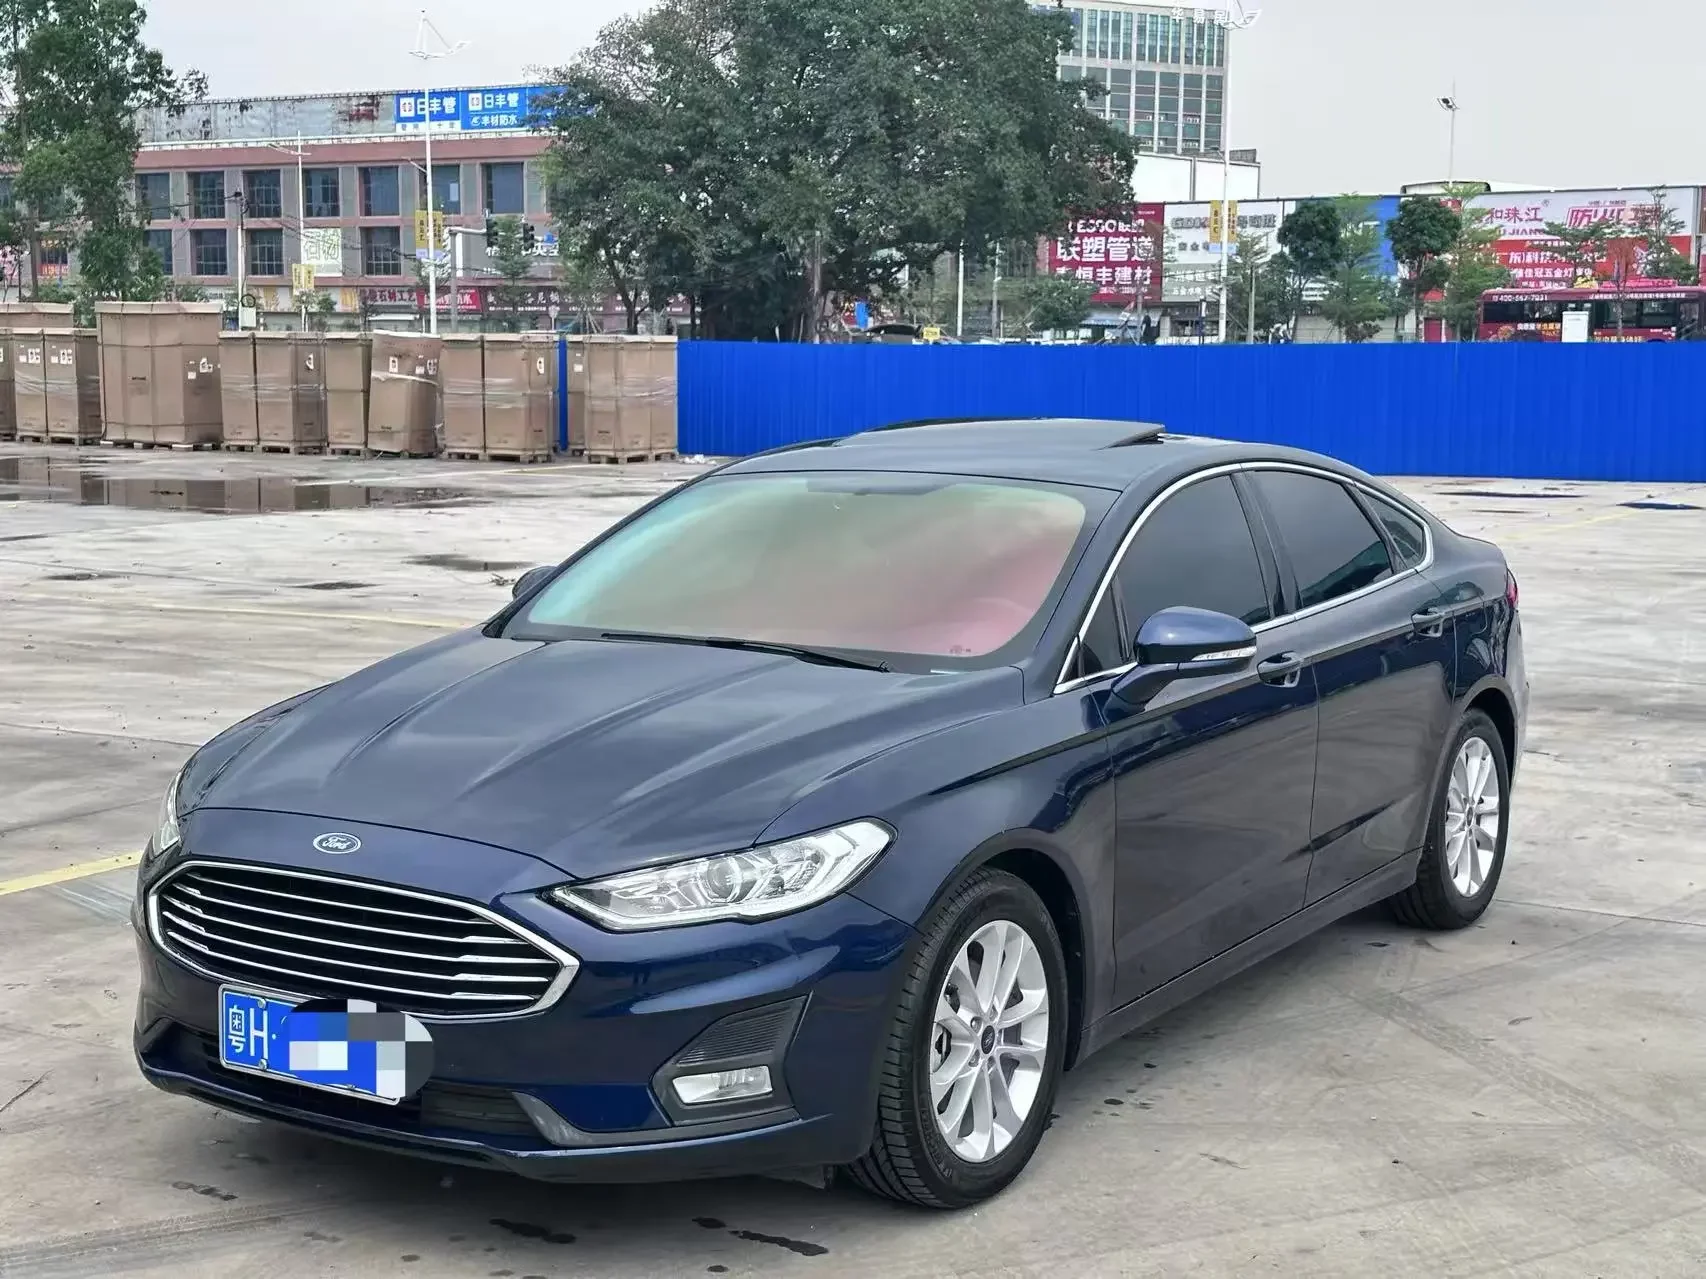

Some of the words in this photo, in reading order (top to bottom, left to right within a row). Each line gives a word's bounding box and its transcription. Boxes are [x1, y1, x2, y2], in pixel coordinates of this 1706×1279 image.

[416, 96, 457, 115] 日丰管
[484, 92, 520, 109] 日丰管
[1056, 235, 1155, 262] 联塑管道
[322, 836, 351, 850] Ford
